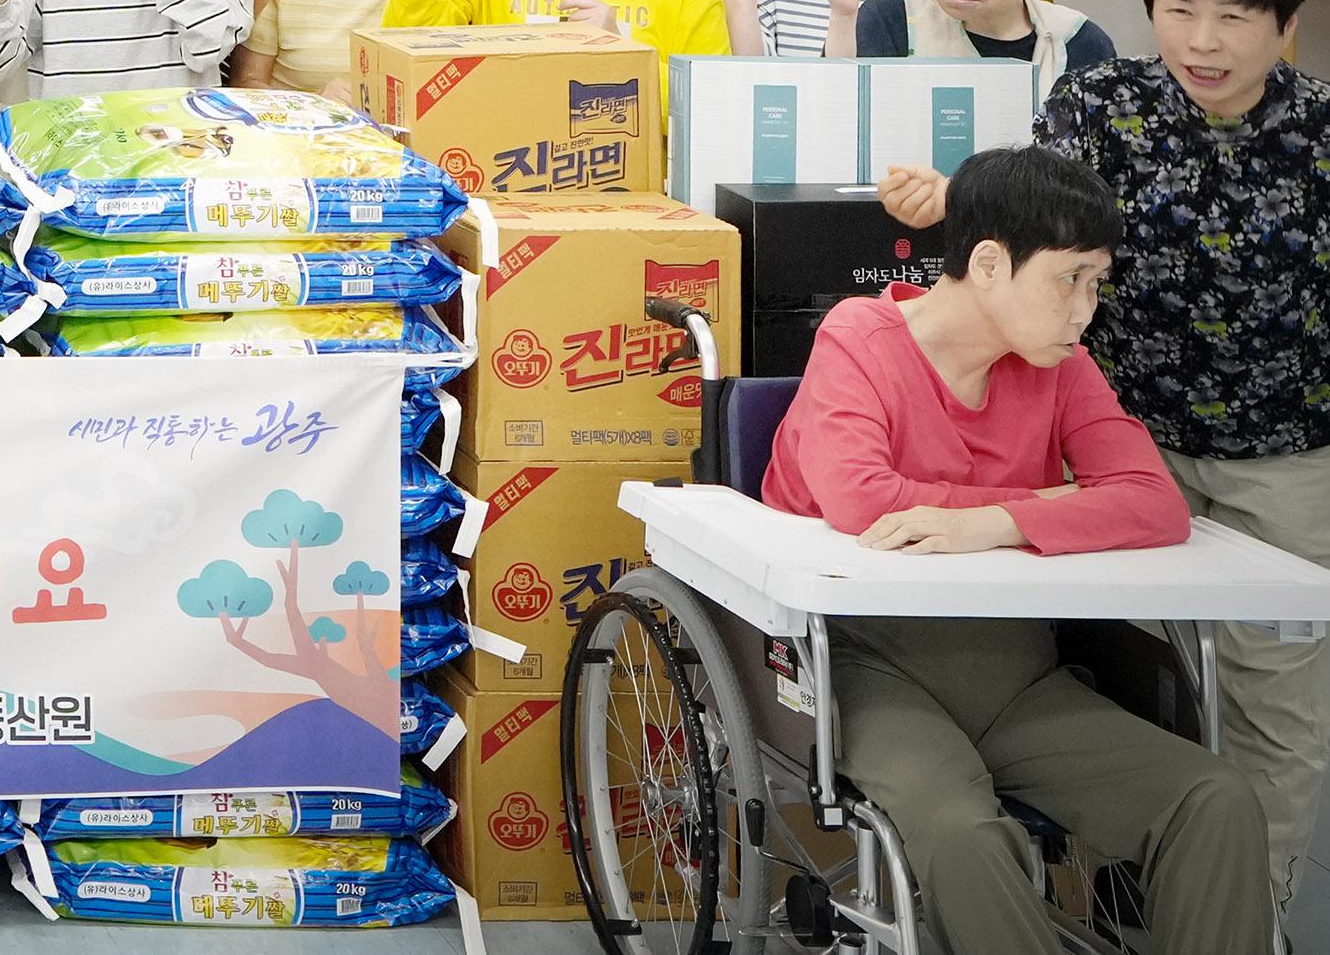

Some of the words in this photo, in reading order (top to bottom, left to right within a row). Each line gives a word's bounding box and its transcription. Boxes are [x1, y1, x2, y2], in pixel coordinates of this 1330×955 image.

[425, 63, 461, 100] 멀티팩
[579, 97, 628, 120] 진라면
[492, 140, 626, 192] 진라면
[206, 202, 301, 228] 메뚜기쌀
[497, 242, 535, 280] 멀티팩
[196, 279, 291, 304] 메뚜기쌀
[503, 360, 541, 377] 오뚜기
[68, 416, 137, 450] 시민과
[239, 399, 340, 458] 광주
[493, 474, 532, 512] 멀티팩
[504, 595, 541, 610] 오뚜기
[493, 707, 533, 743] 멀티팩
[192, 815, 283, 836] 메뚜기쌀
[500, 823, 537, 839] 오뚜기
[191, 894, 286, 921] 메뚜기쌀
